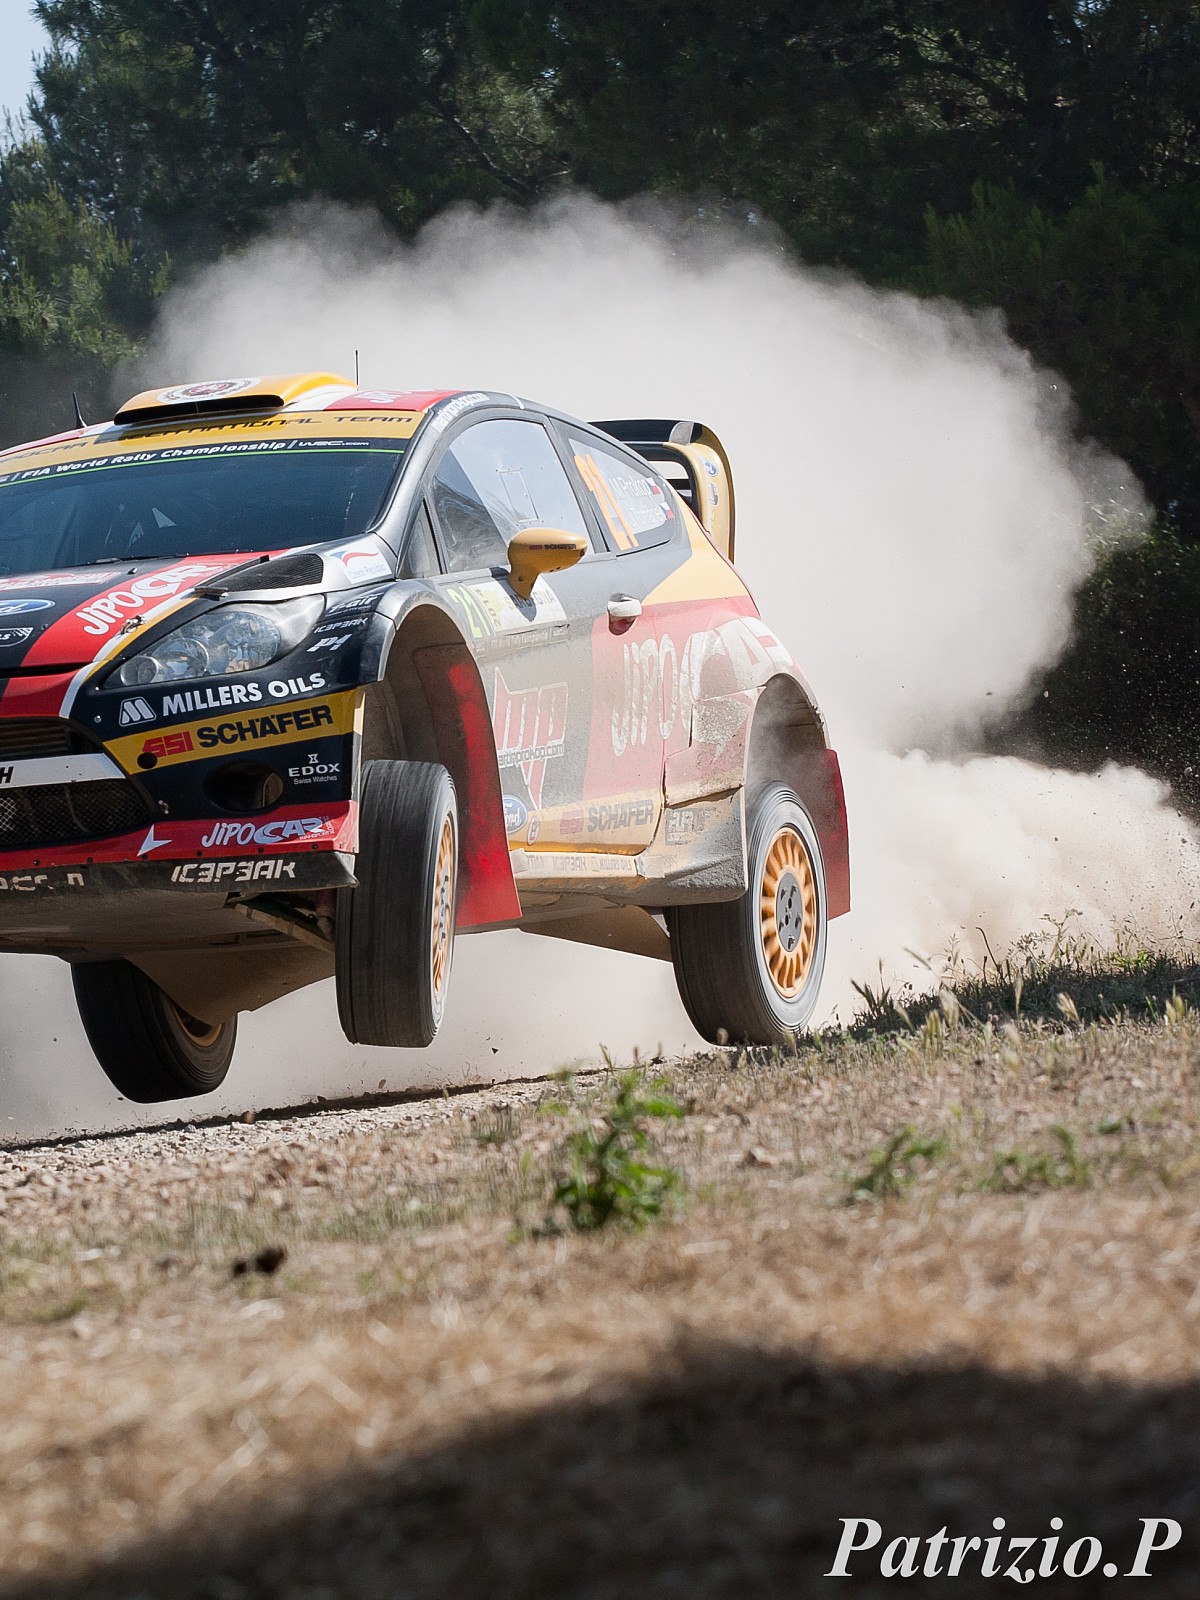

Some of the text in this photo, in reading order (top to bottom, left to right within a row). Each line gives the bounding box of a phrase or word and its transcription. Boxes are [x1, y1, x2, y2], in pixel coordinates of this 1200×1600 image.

[334, 416, 413, 424] TEAM
[21, 467, 50, 479] FIA
[56, 457, 108, 473] World
[111, 447, 156, 466] Rally
[161, 440, 285, 458] Championship
[163, 683, 262, 716] MILLERS
[268, 672, 326, 700] OILS
[197, 704, 334, 747] SCHÄFER
[288, 762, 340, 777] EDOX
[293, 774, 338, 785] Swiss Watches
